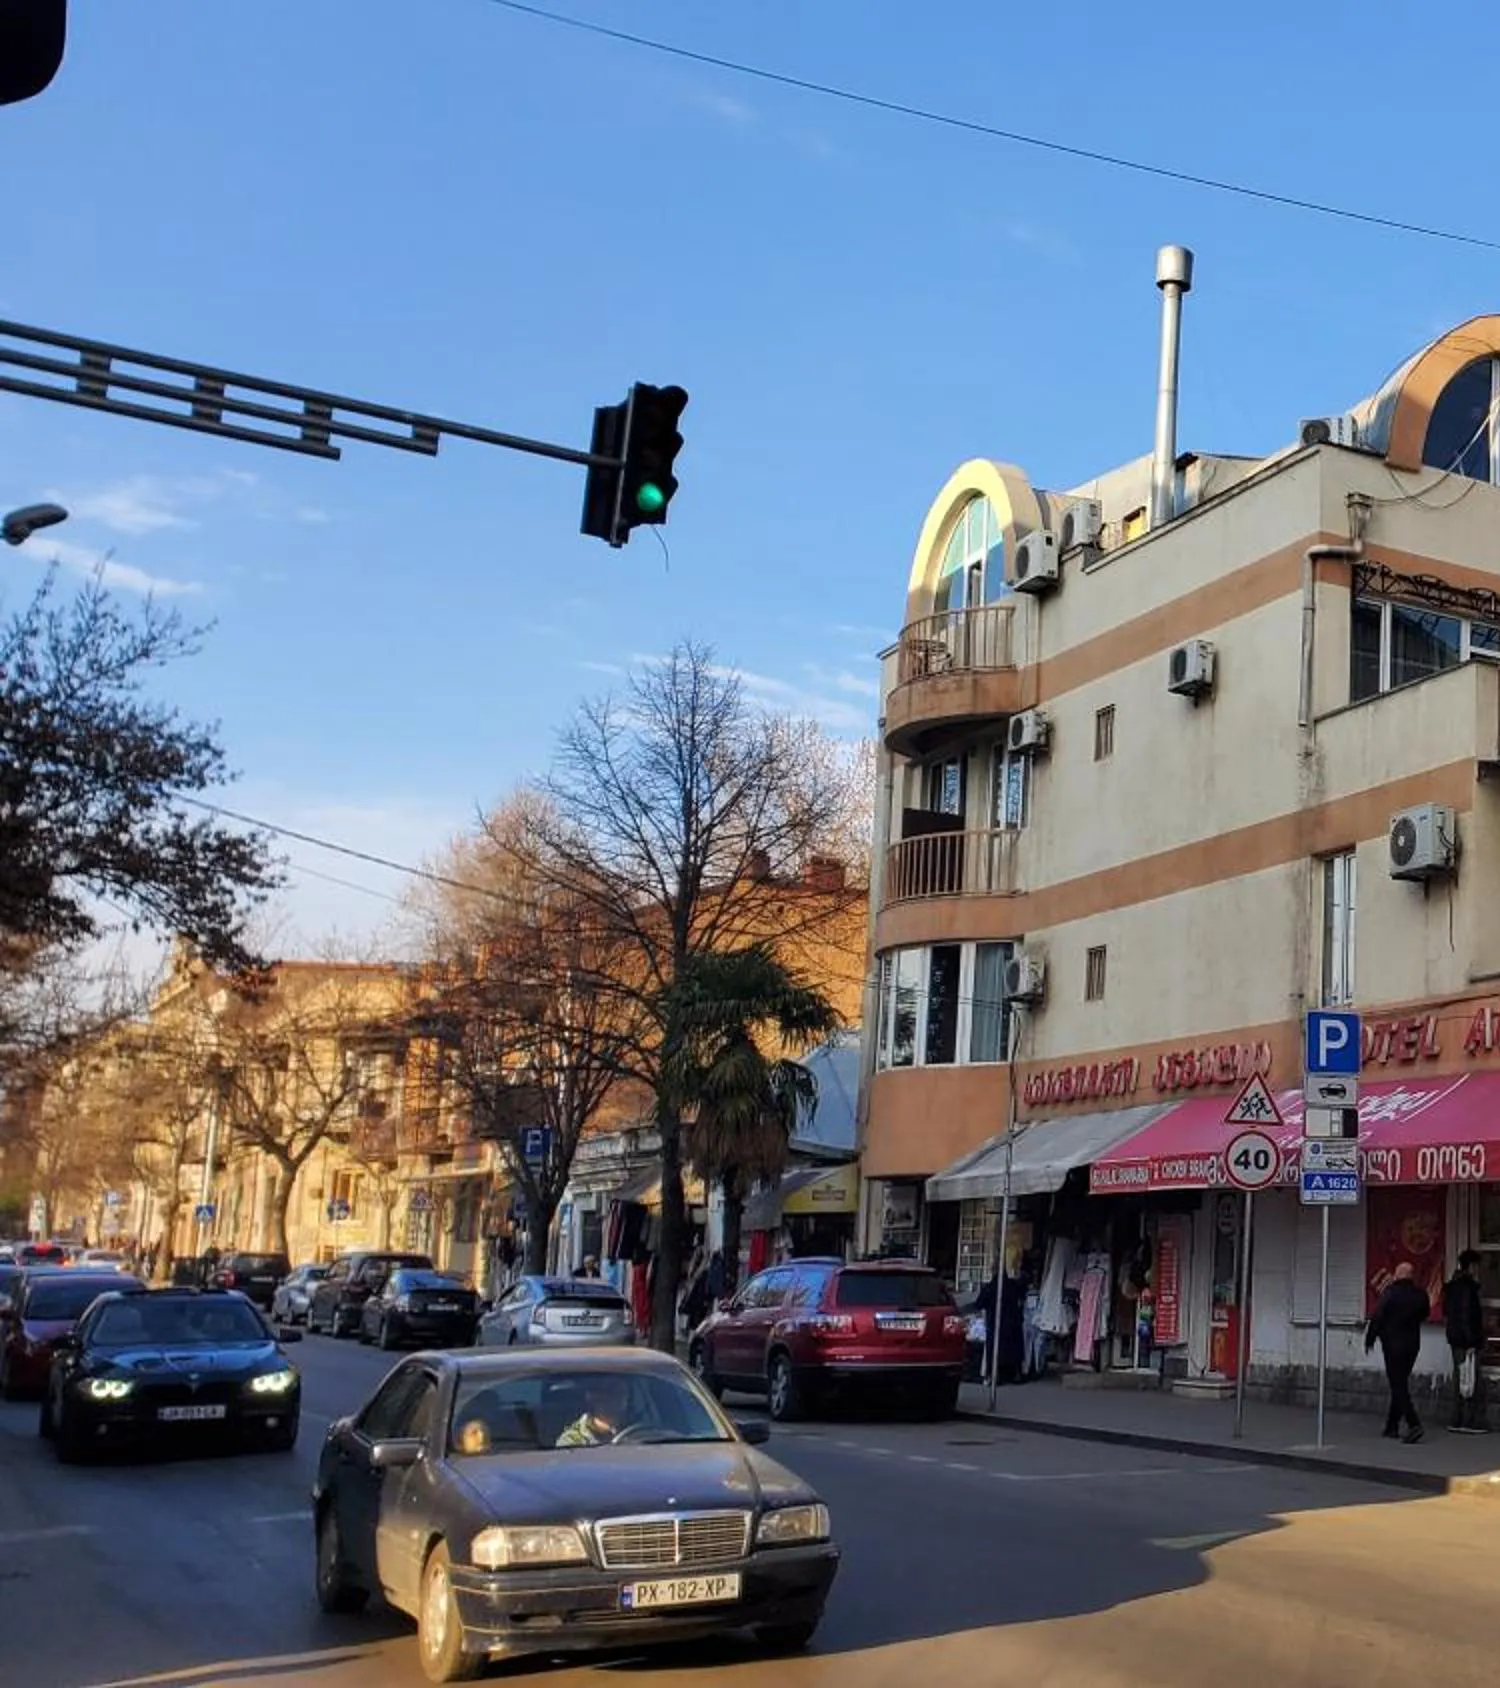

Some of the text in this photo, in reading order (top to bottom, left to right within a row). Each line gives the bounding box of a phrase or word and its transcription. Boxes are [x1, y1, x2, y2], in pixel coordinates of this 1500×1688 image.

[1318, 1018, 1349, 1067] P
[1233, 1148, 1269, 1171] 40
[1417, 1144, 1485, 1181] თონე
[1311, 1175, 1357, 1189] A 1620
[636, 1577, 727, 1603] PX-182-XP
